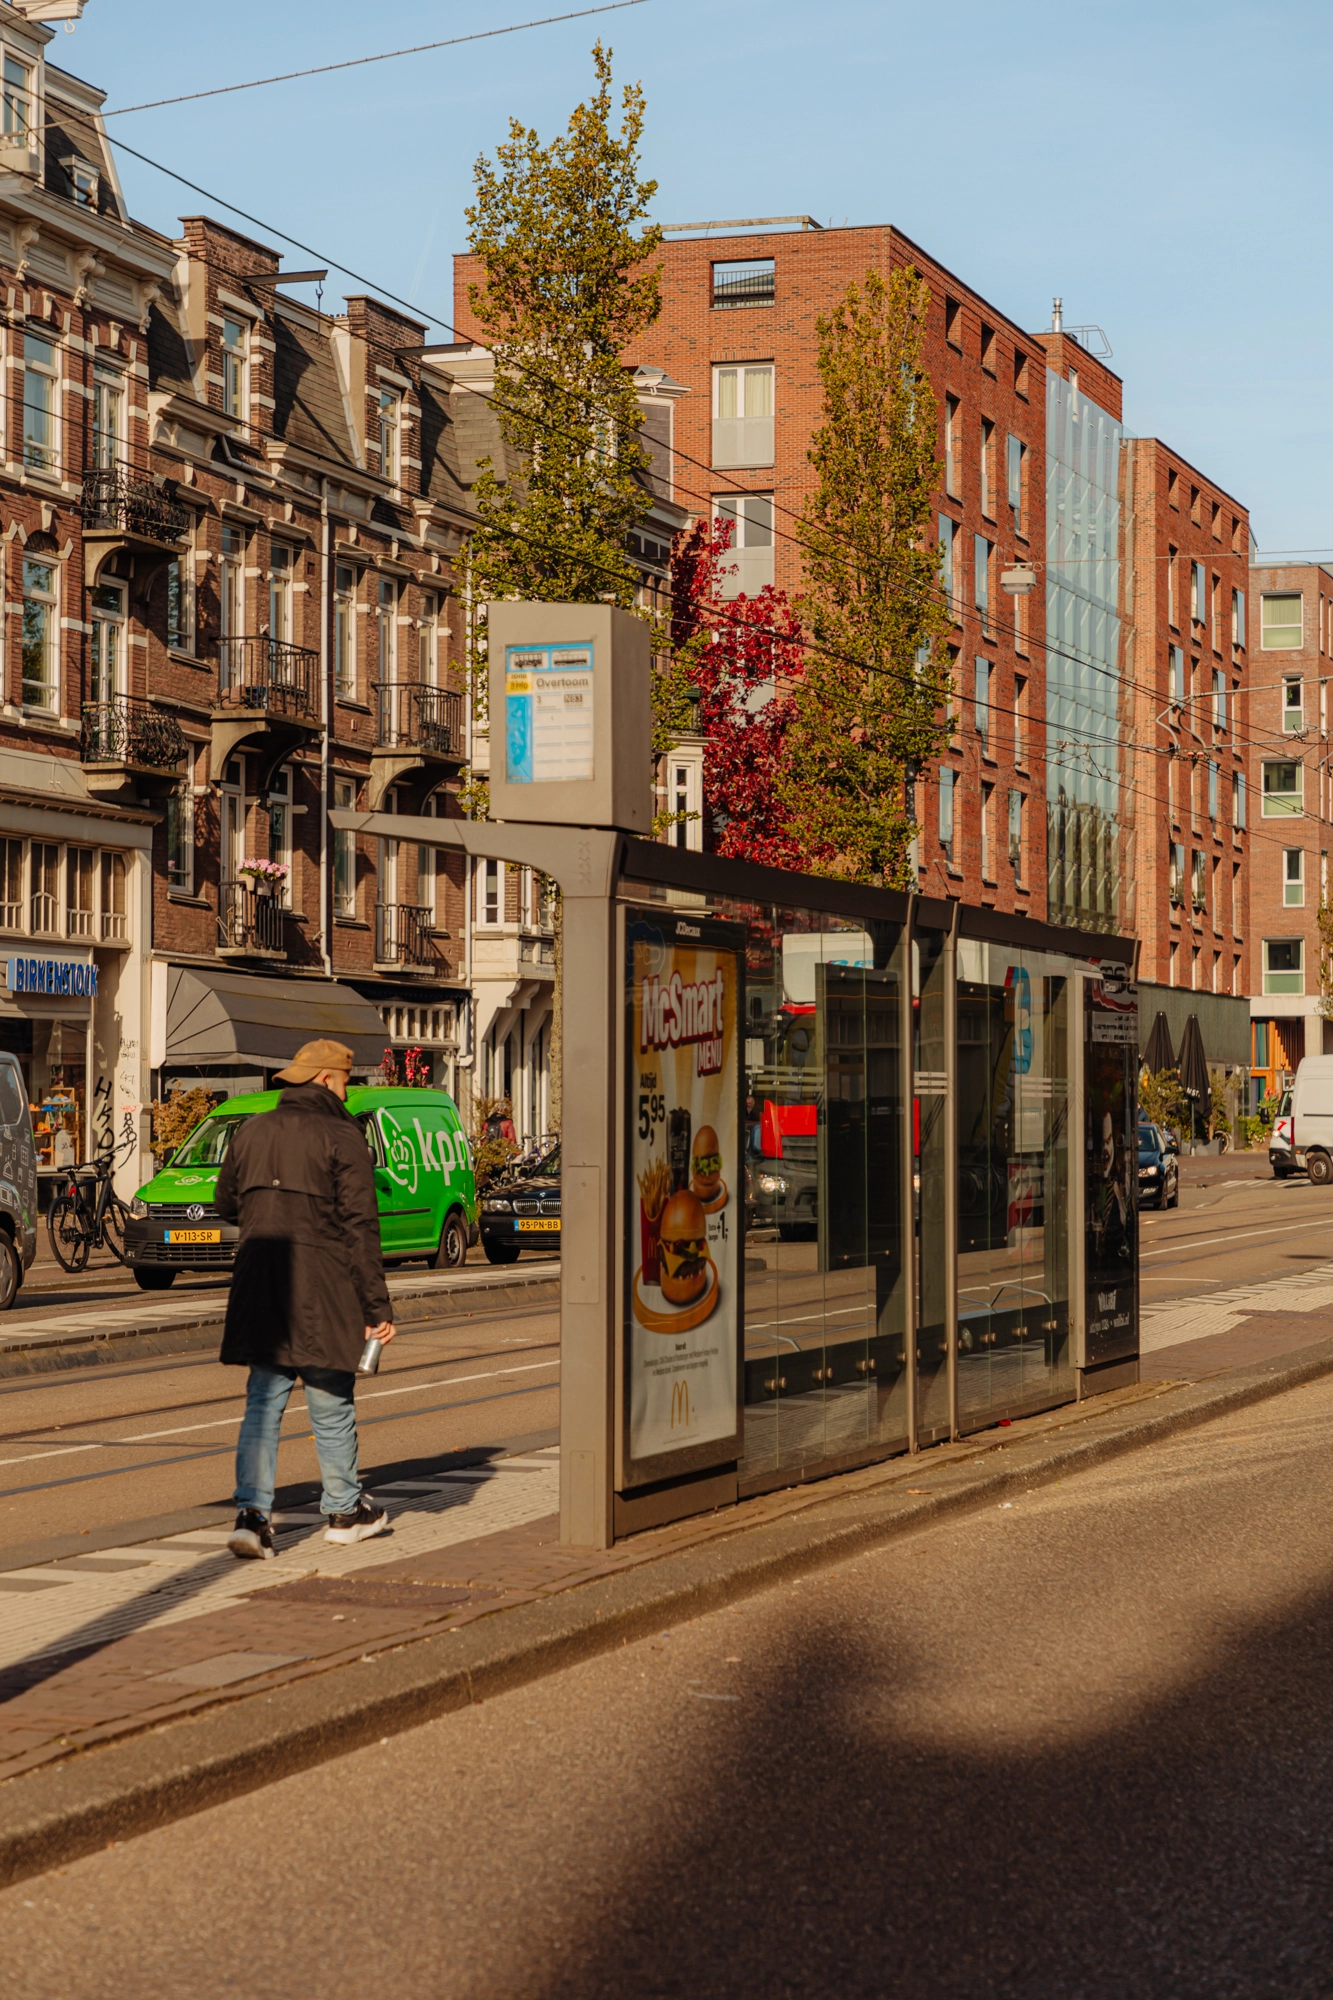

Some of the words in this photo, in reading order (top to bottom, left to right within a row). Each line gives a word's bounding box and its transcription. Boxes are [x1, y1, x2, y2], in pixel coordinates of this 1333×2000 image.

[536, 677, 589, 688] Overtoom
[536, 695, 543, 705] 3
[675, 921, 701, 938] JCDecaux
[16, 958, 98, 998] BIRKENSTOCK
[641, 967, 724, 1050] McSmart
[697, 1038, 722, 1073] MENU
[412, 1117, 474, 1187] kpn
[520, 1221, 558, 1229] 95-PN-BB
[174, 1231, 213, 1241] V-113-SR
